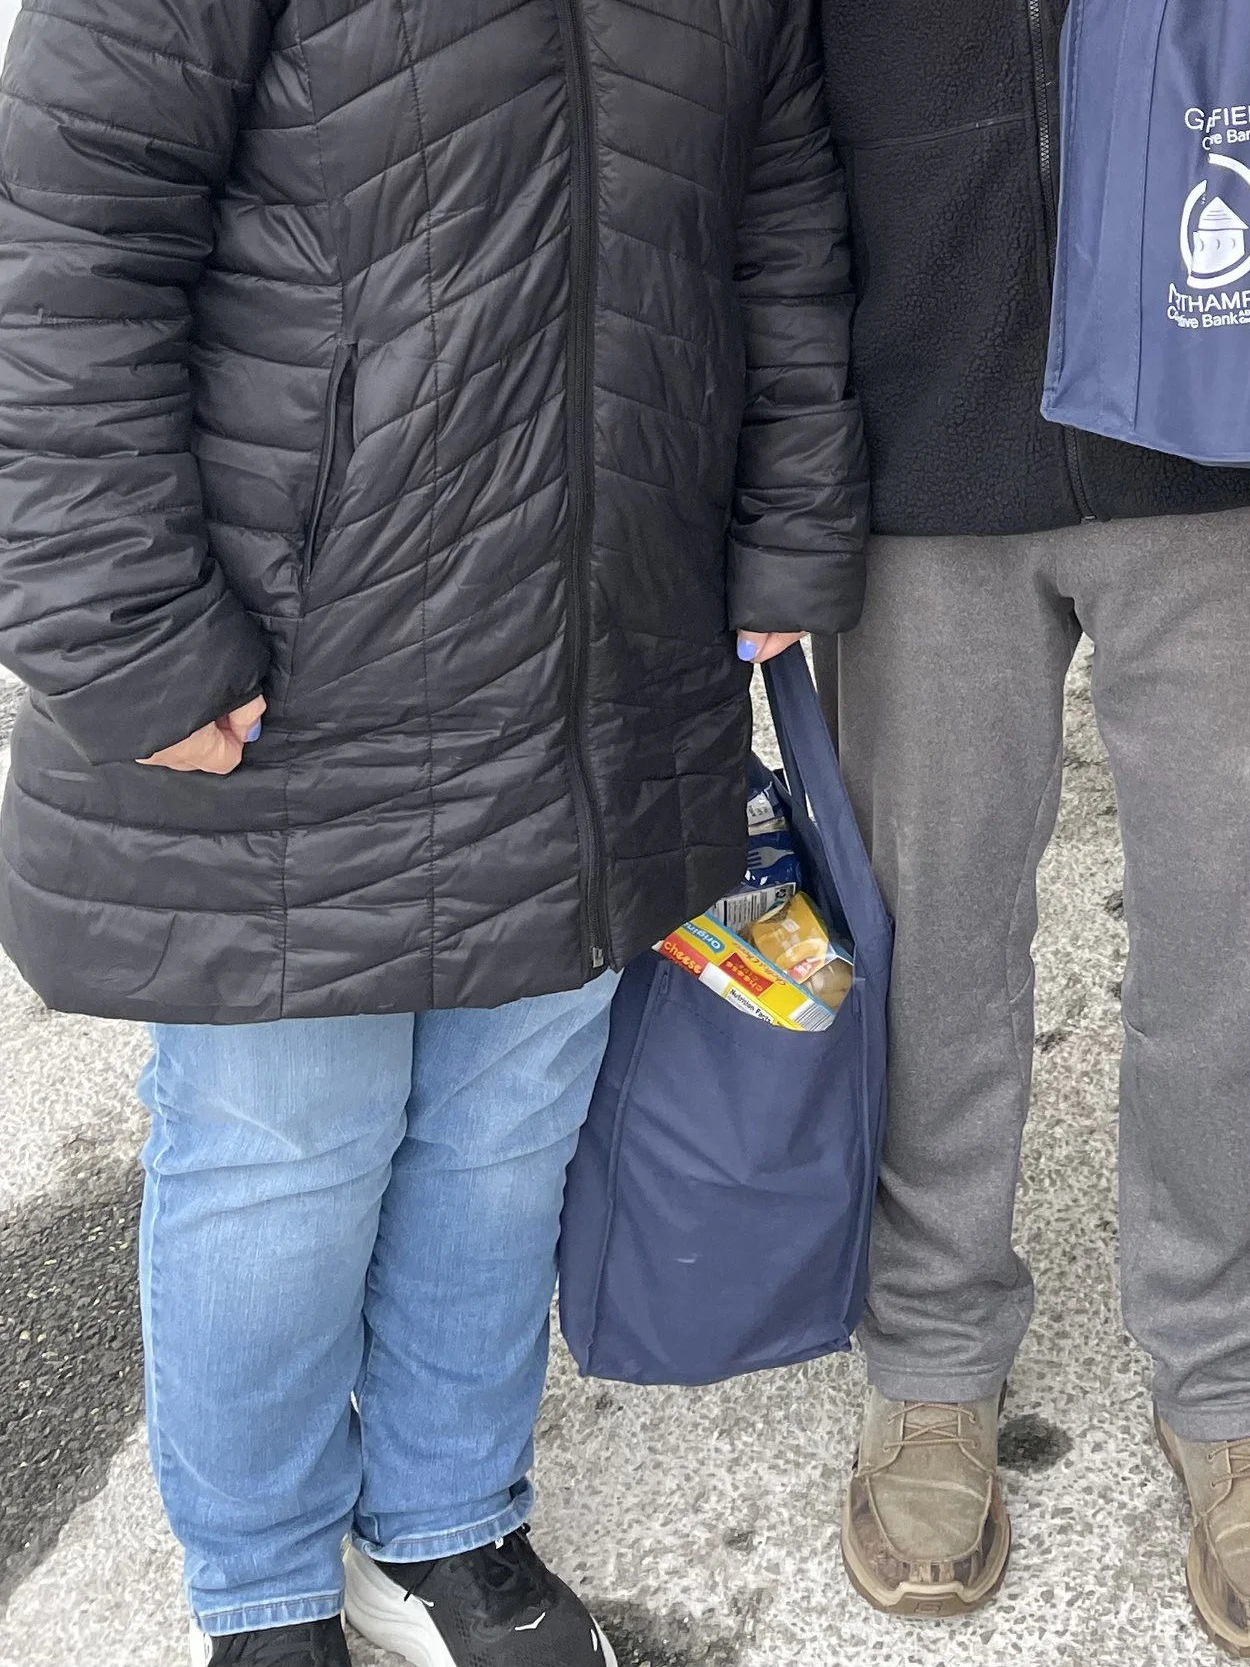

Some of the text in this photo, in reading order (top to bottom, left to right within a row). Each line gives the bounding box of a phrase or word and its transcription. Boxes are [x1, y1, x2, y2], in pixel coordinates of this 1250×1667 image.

[1201, 311, 1239, 328] Bank
[663, 941, 702, 975] cheese
[725, 960, 763, 993] cheese
[730, 988, 754, 1011] Nutrition
